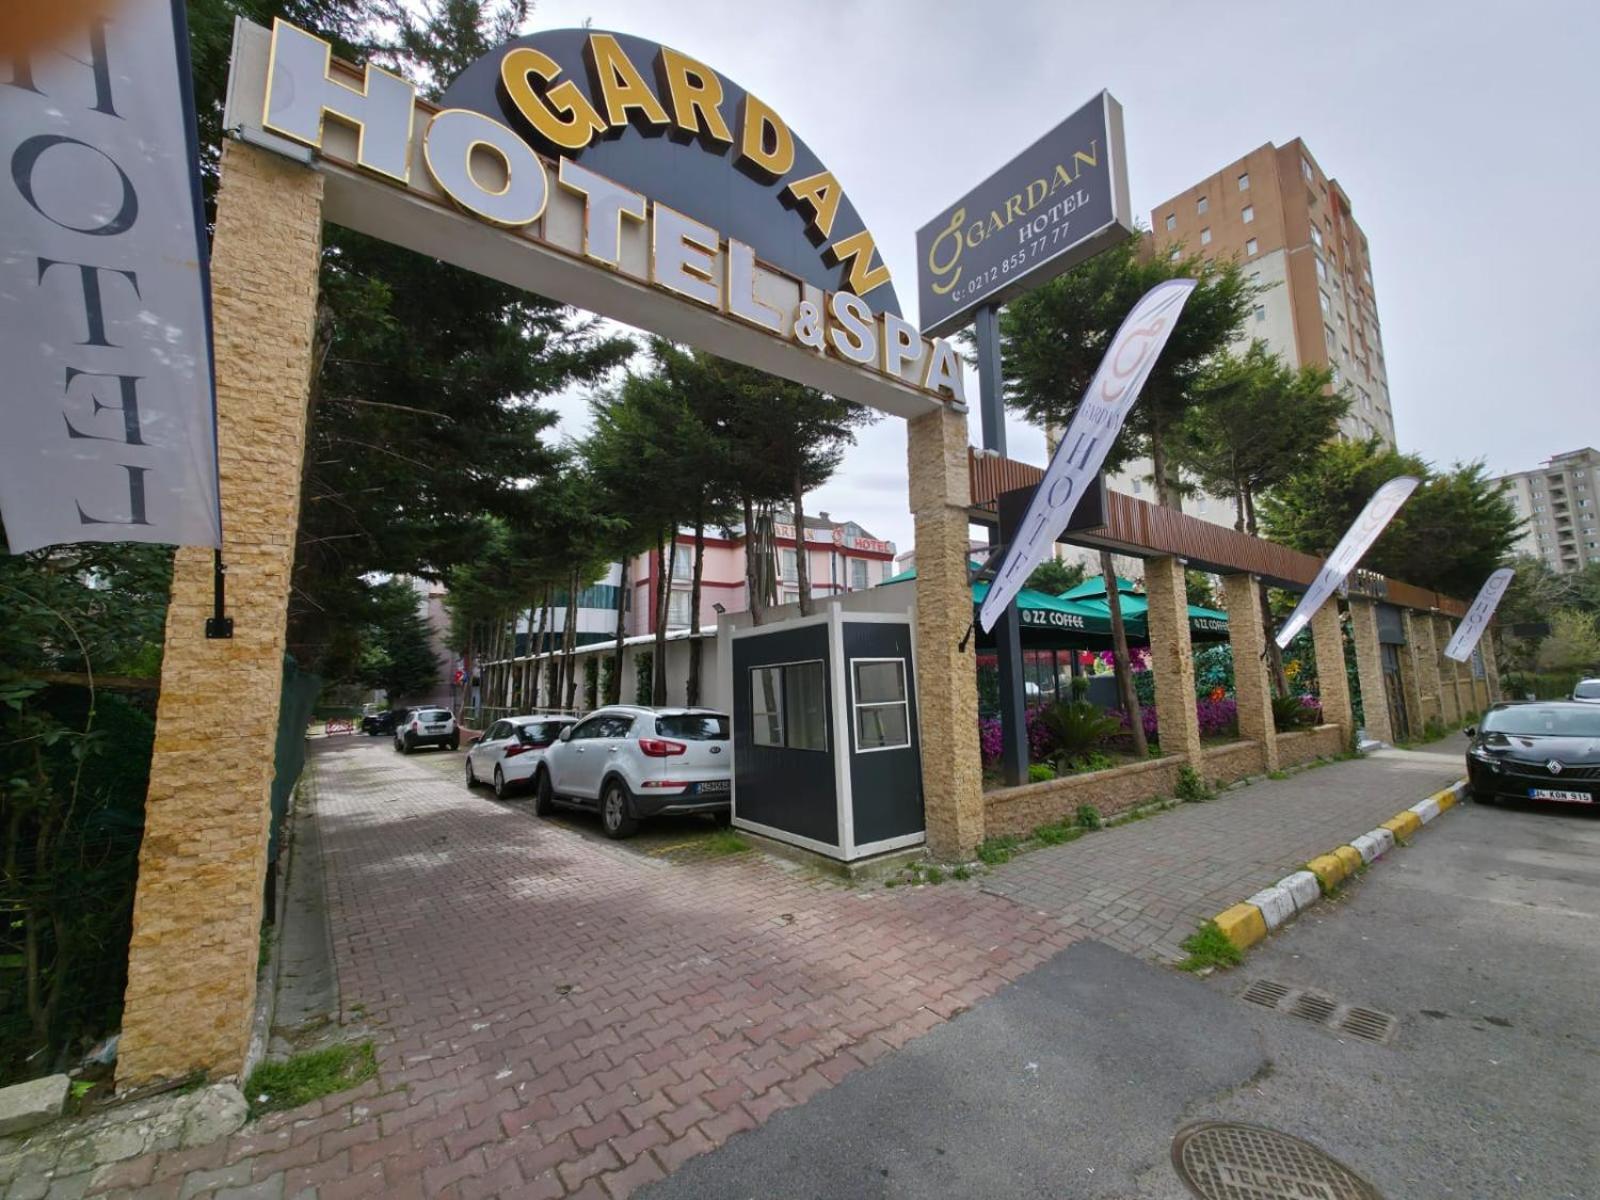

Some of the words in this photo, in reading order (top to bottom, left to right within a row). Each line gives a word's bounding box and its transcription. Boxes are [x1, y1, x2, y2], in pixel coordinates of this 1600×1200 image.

[262, 15, 787, 334] HOTEL
[499, 32, 893, 297] GARDAN
[965, 139, 1098, 249] GARDAN
[1018, 188, 1090, 245] HOTEL
[968, 266, 998, 294] 0212
[1001, 248, 1026, 273] 855
[1030, 237, 1047, 258] 77
[1052, 221, 1070, 245] 77
[854, 537, 890, 552] HOTEL
[1032, 610, 1047, 624] ZZ
[1049, 611, 1085, 629] COFFEE
[1223, 1166, 1331, 1199] TELEFON
